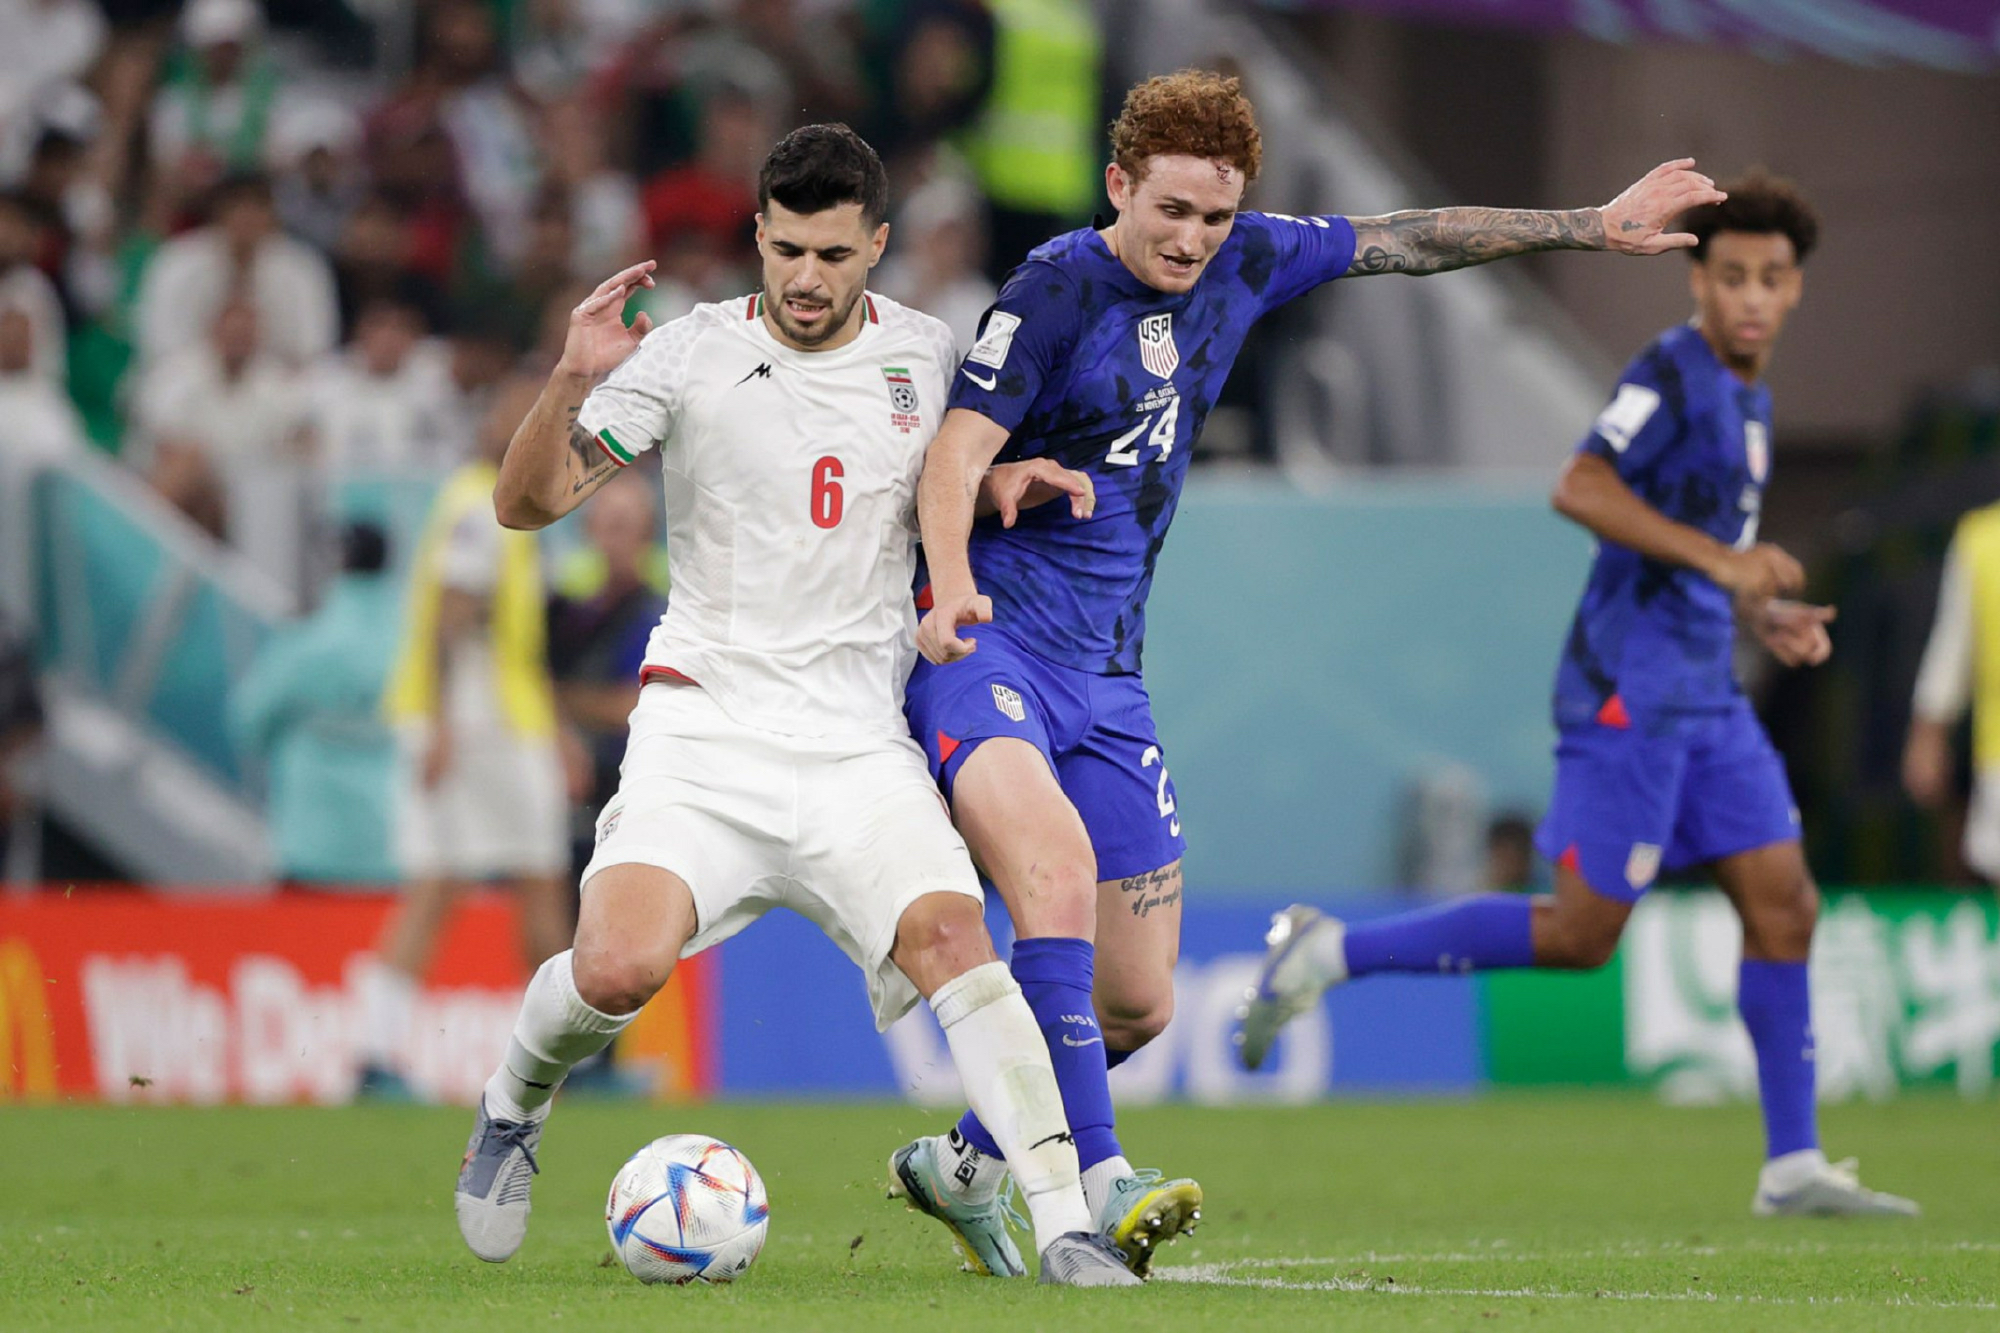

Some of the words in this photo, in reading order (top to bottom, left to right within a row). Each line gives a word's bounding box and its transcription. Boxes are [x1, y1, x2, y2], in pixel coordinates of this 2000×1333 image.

[1141, 317, 1169, 343] USA
[1105, 395, 1181, 466] 24
[810, 455, 844, 529] 6
[993, 685, 1020, 702] USA
[1060, 1014, 1097, 1029] USA
